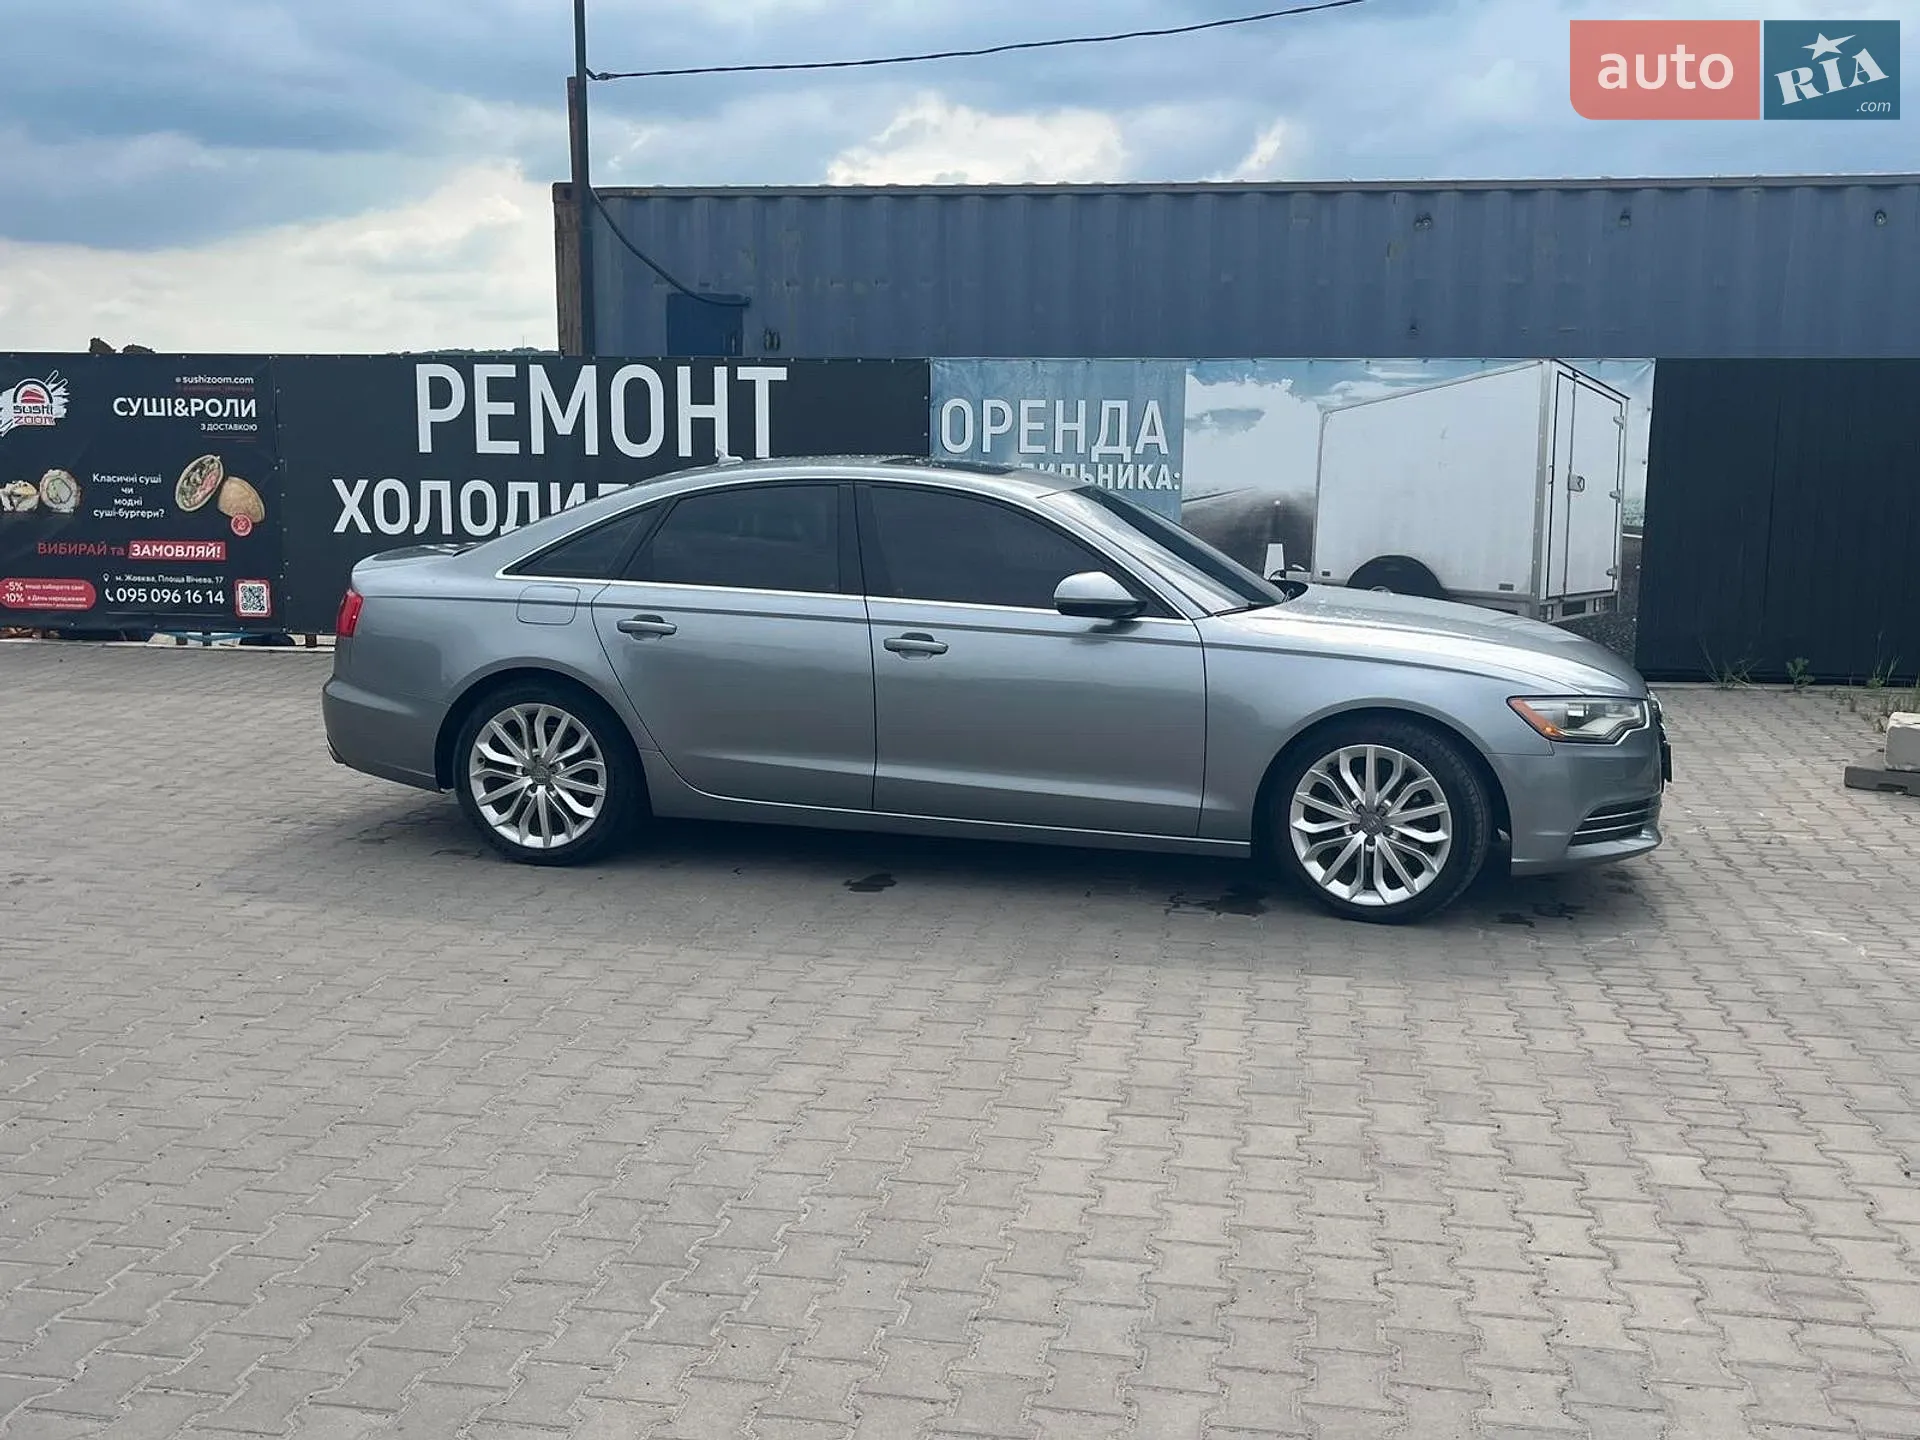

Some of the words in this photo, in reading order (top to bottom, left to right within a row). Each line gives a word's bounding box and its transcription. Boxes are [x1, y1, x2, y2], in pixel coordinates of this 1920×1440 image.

[182, 374, 254, 384] sushizoom.com
[112, 397, 256, 418] СУШІ&РОЛИ
[415, 363, 788, 459] РЕМОНТ
[207, 424, 258, 432] ДОСТАВКОЮ
[940, 398, 1169, 463] ОРЕНДА
[92, 473, 138, 483] Класичні
[139, 474, 162, 485] суші
[114, 497, 143, 507] модні
[332, 478, 632, 537] ХОЛОДИ
[93, 508, 165, 519] суші-бургери?
[38, 542, 107, 556] ВИБИРАЙ
[131, 543, 221, 558] ЗАМОВЛЯЙ!
[116, 588, 147, 603] 095
[150, 588, 181, 604] 096
[184, 589, 203, 604] 16
[205, 590, 225, 604] 14
